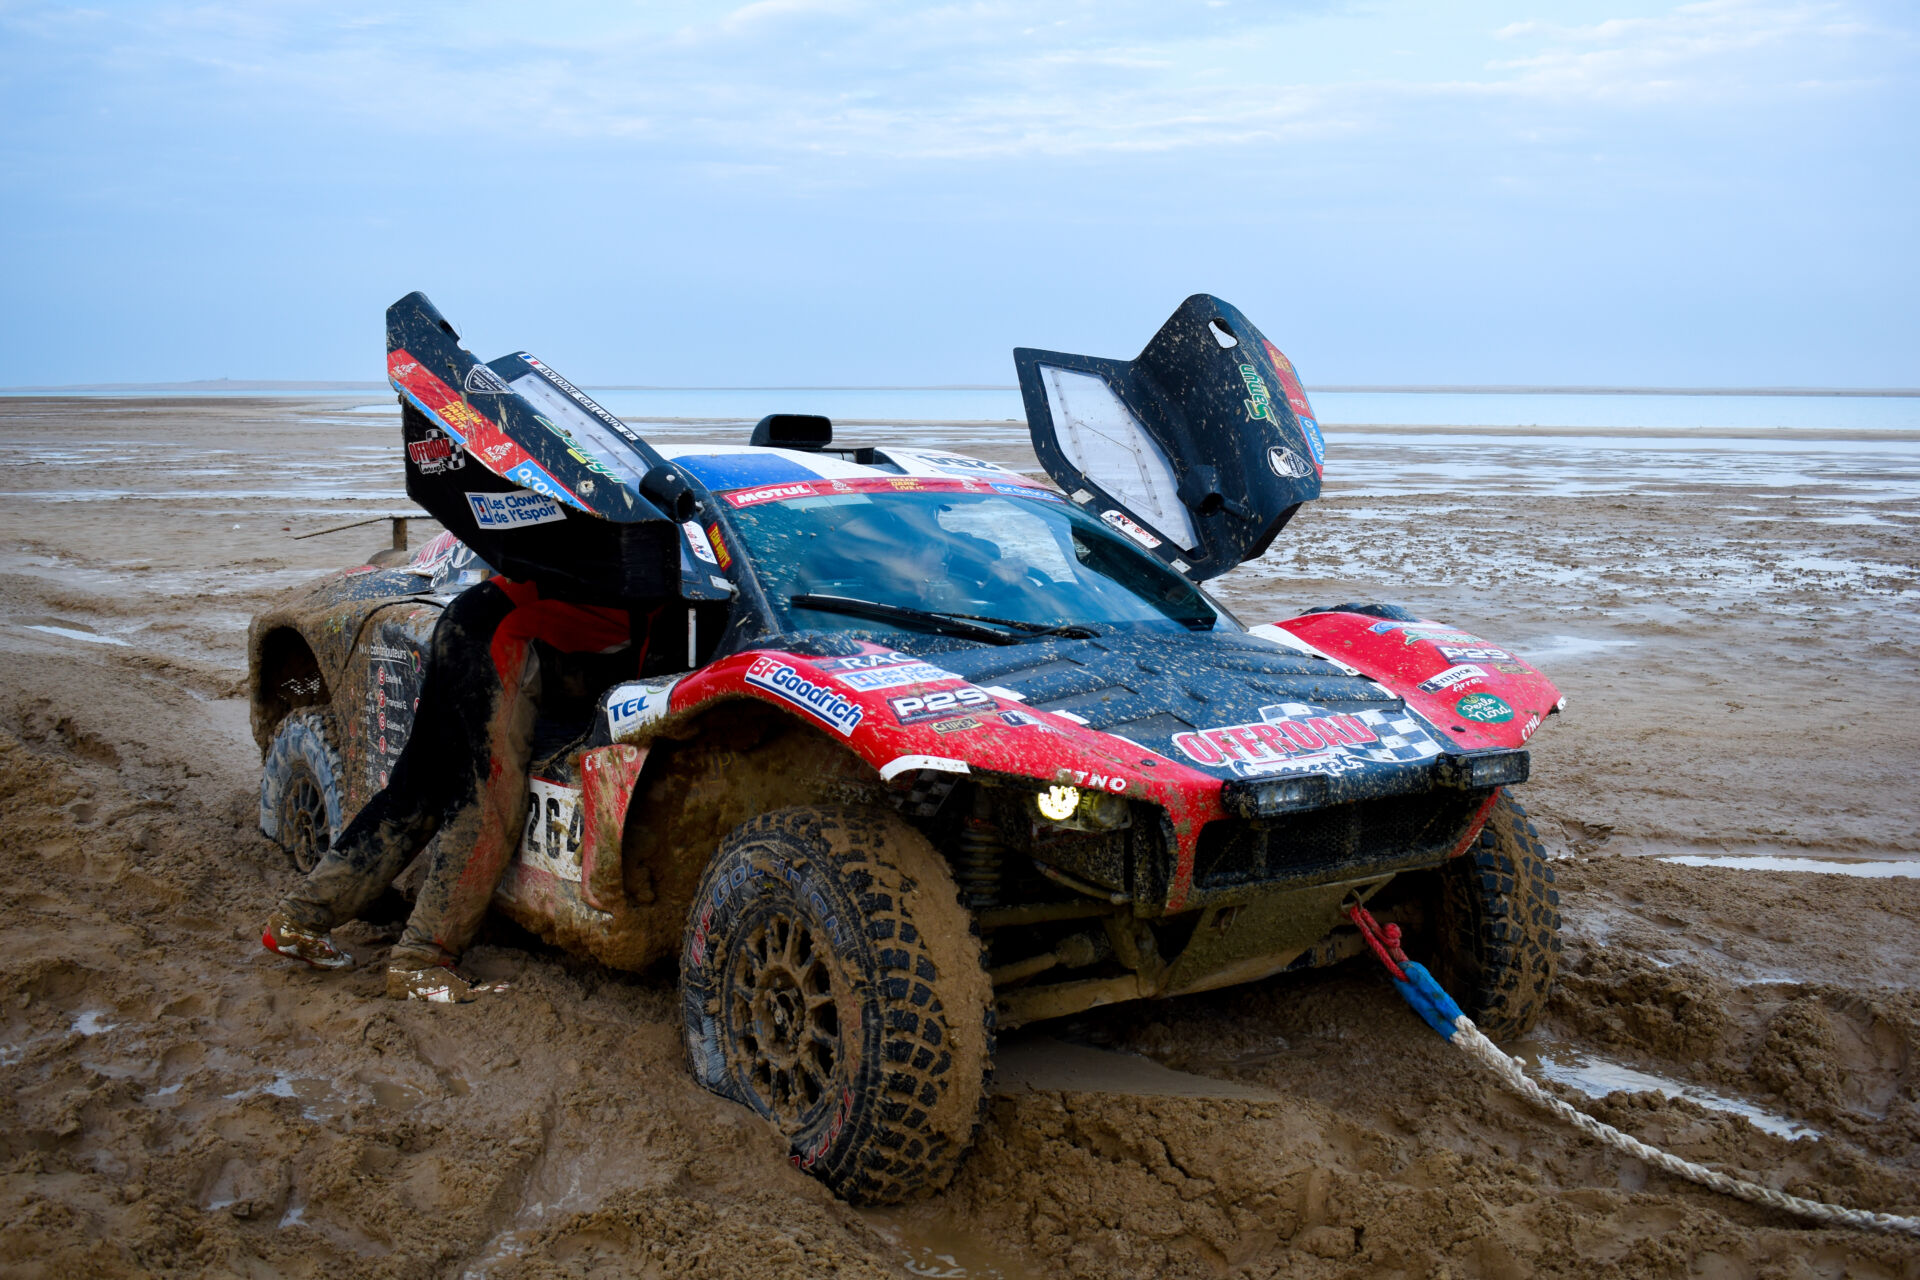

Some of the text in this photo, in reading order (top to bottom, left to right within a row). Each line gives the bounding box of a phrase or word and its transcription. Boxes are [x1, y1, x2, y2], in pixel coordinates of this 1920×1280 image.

[540, 366, 579, 396] ANTOINE
[578, 396, 620, 428] GALLAND
[409, 438, 451, 461] OFFROAD
[488, 497, 503, 510] Les
[737, 484, 811, 504] MOTUL
[495, 511, 508, 524] de
[748, 658, 863, 727] BFGoodrich
[893, 687, 989, 717] P2S
[1462, 697, 1496, 713] Perle
[1468, 704, 1512, 721] Nord
[1177, 714, 1379, 764] OFFROAD
[527, 791, 584, 860] 264
